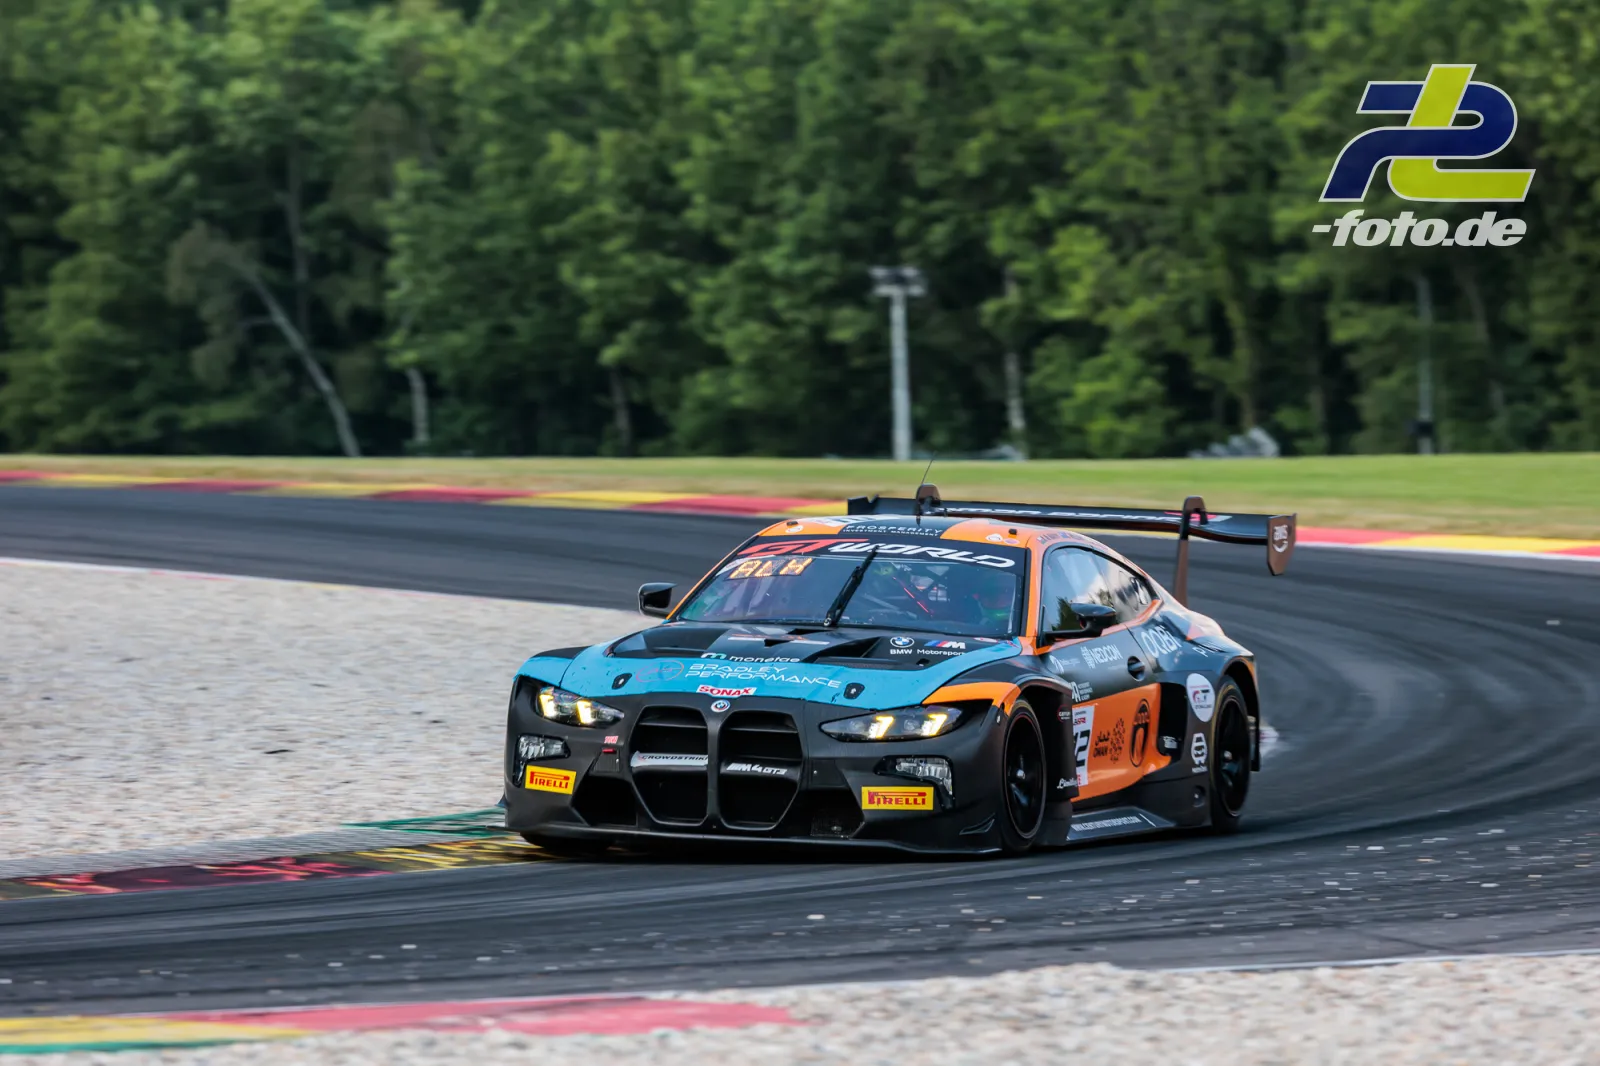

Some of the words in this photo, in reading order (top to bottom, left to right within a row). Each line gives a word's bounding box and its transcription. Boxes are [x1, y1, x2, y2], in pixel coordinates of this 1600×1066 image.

[846, 525, 943, 533] PROSPERITY
[690, 664, 788, 673] BRADLEY
[685, 670, 842, 688] PERFORMANCE
[698, 686, 751, 696] SONAX
[529, 771, 570, 789] PIRELLI
[868, 791, 927, 806] PIRELLI
